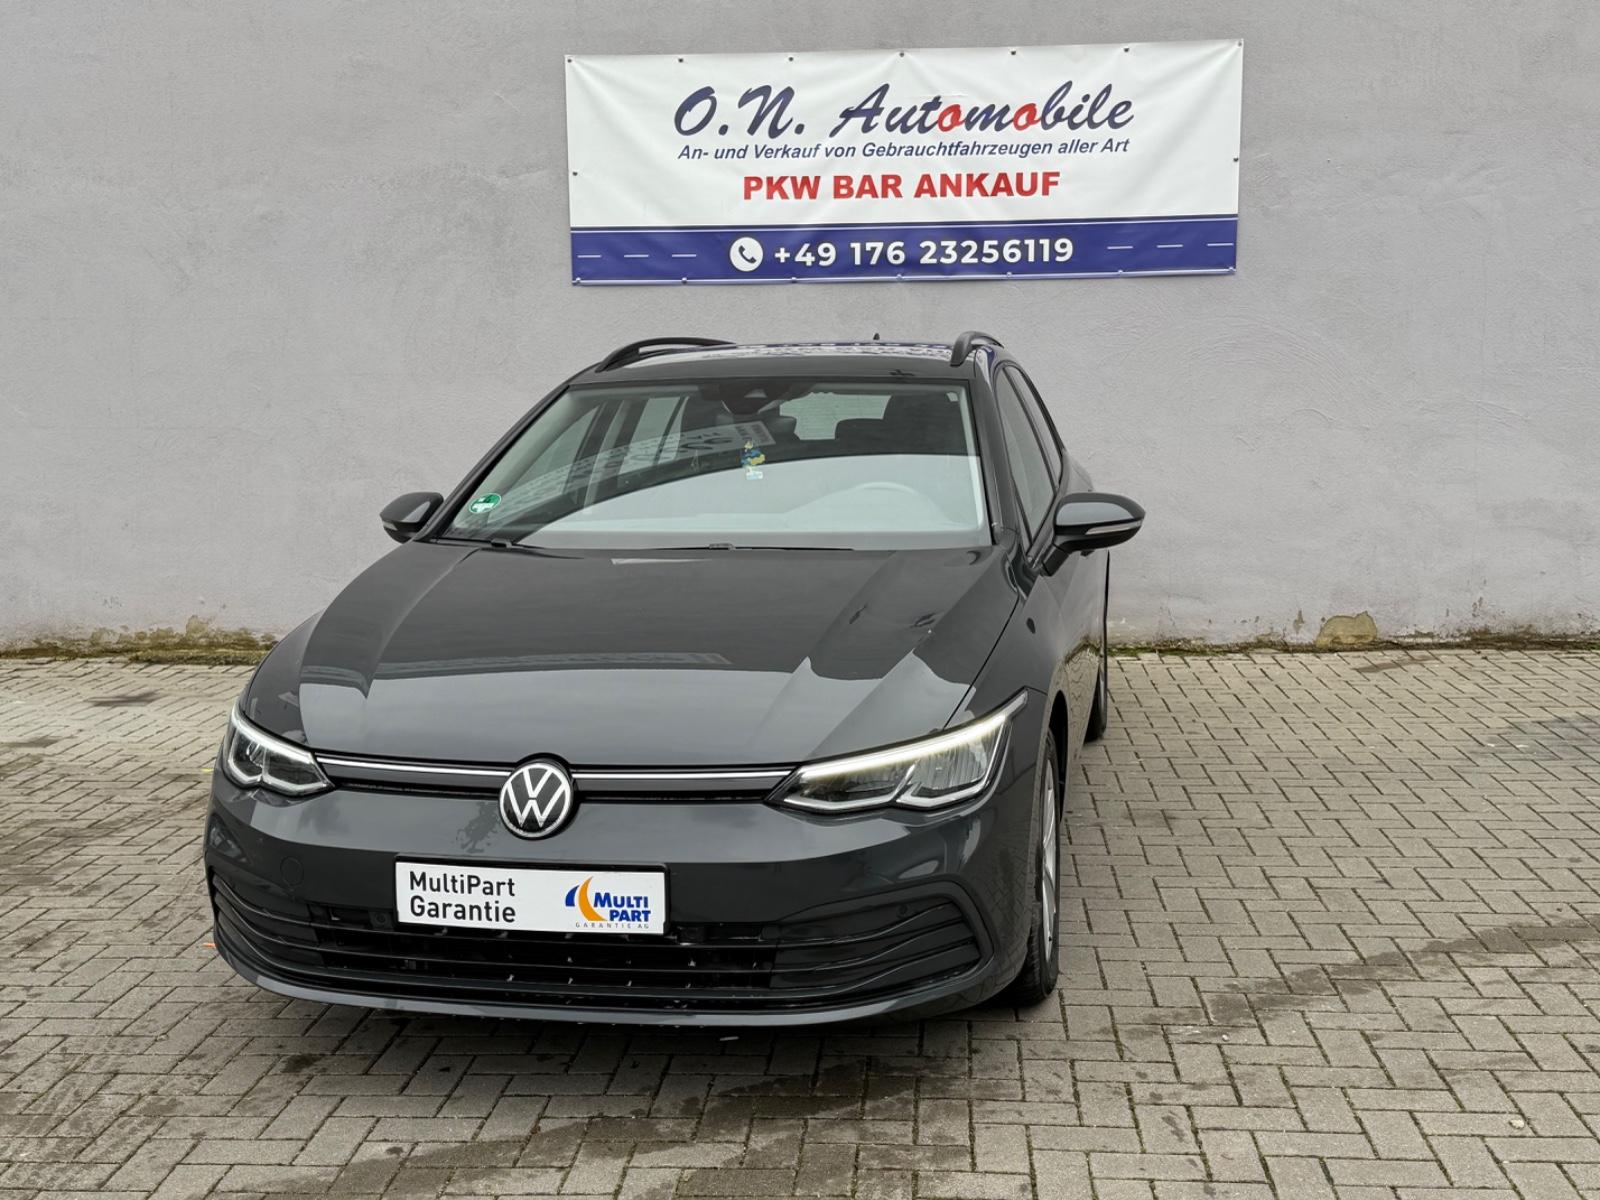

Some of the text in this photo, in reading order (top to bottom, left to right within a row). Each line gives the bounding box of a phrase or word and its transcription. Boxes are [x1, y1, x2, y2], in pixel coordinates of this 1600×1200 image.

[828, 80, 1134, 138] Automobile
[677, 138, 1131, 160] An- und Verkauf von Gebrauchtfahrzeugen aller Art
[743, 171, 1061, 200] PKW BAR ANKAUF
[774, 238, 1074, 267] +49 176 23256119
[409, 870, 516, 897] MultiPart
[410, 895, 516, 923] Garantie
[608, 909, 651, 923] PART
[575, 921, 650, 930] GARANTIE AG
